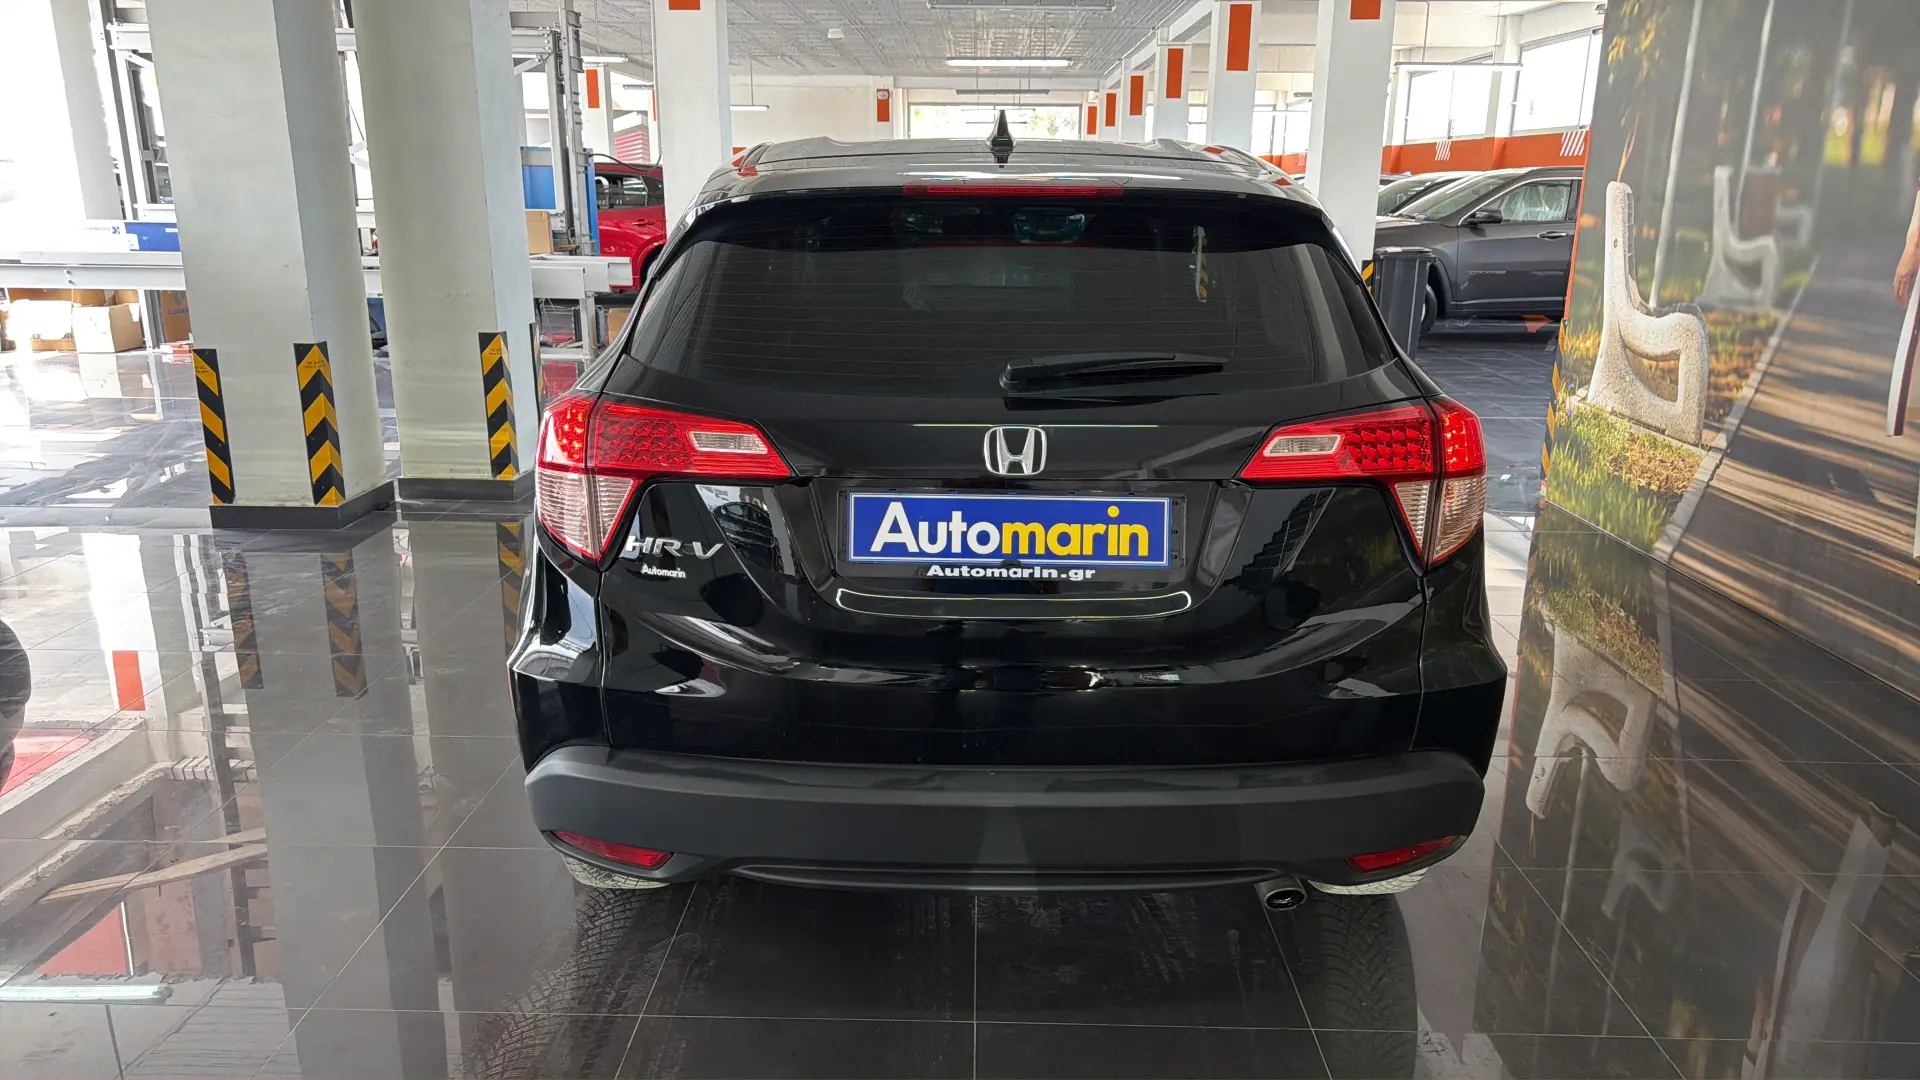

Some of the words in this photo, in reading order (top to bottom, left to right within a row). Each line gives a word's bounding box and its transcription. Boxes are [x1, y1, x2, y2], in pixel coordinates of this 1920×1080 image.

[870, 501, 1149, 557] Automarin
[641, 563, 687, 579] Automarin
[927, 565, 1096, 581] Automarin.gr
